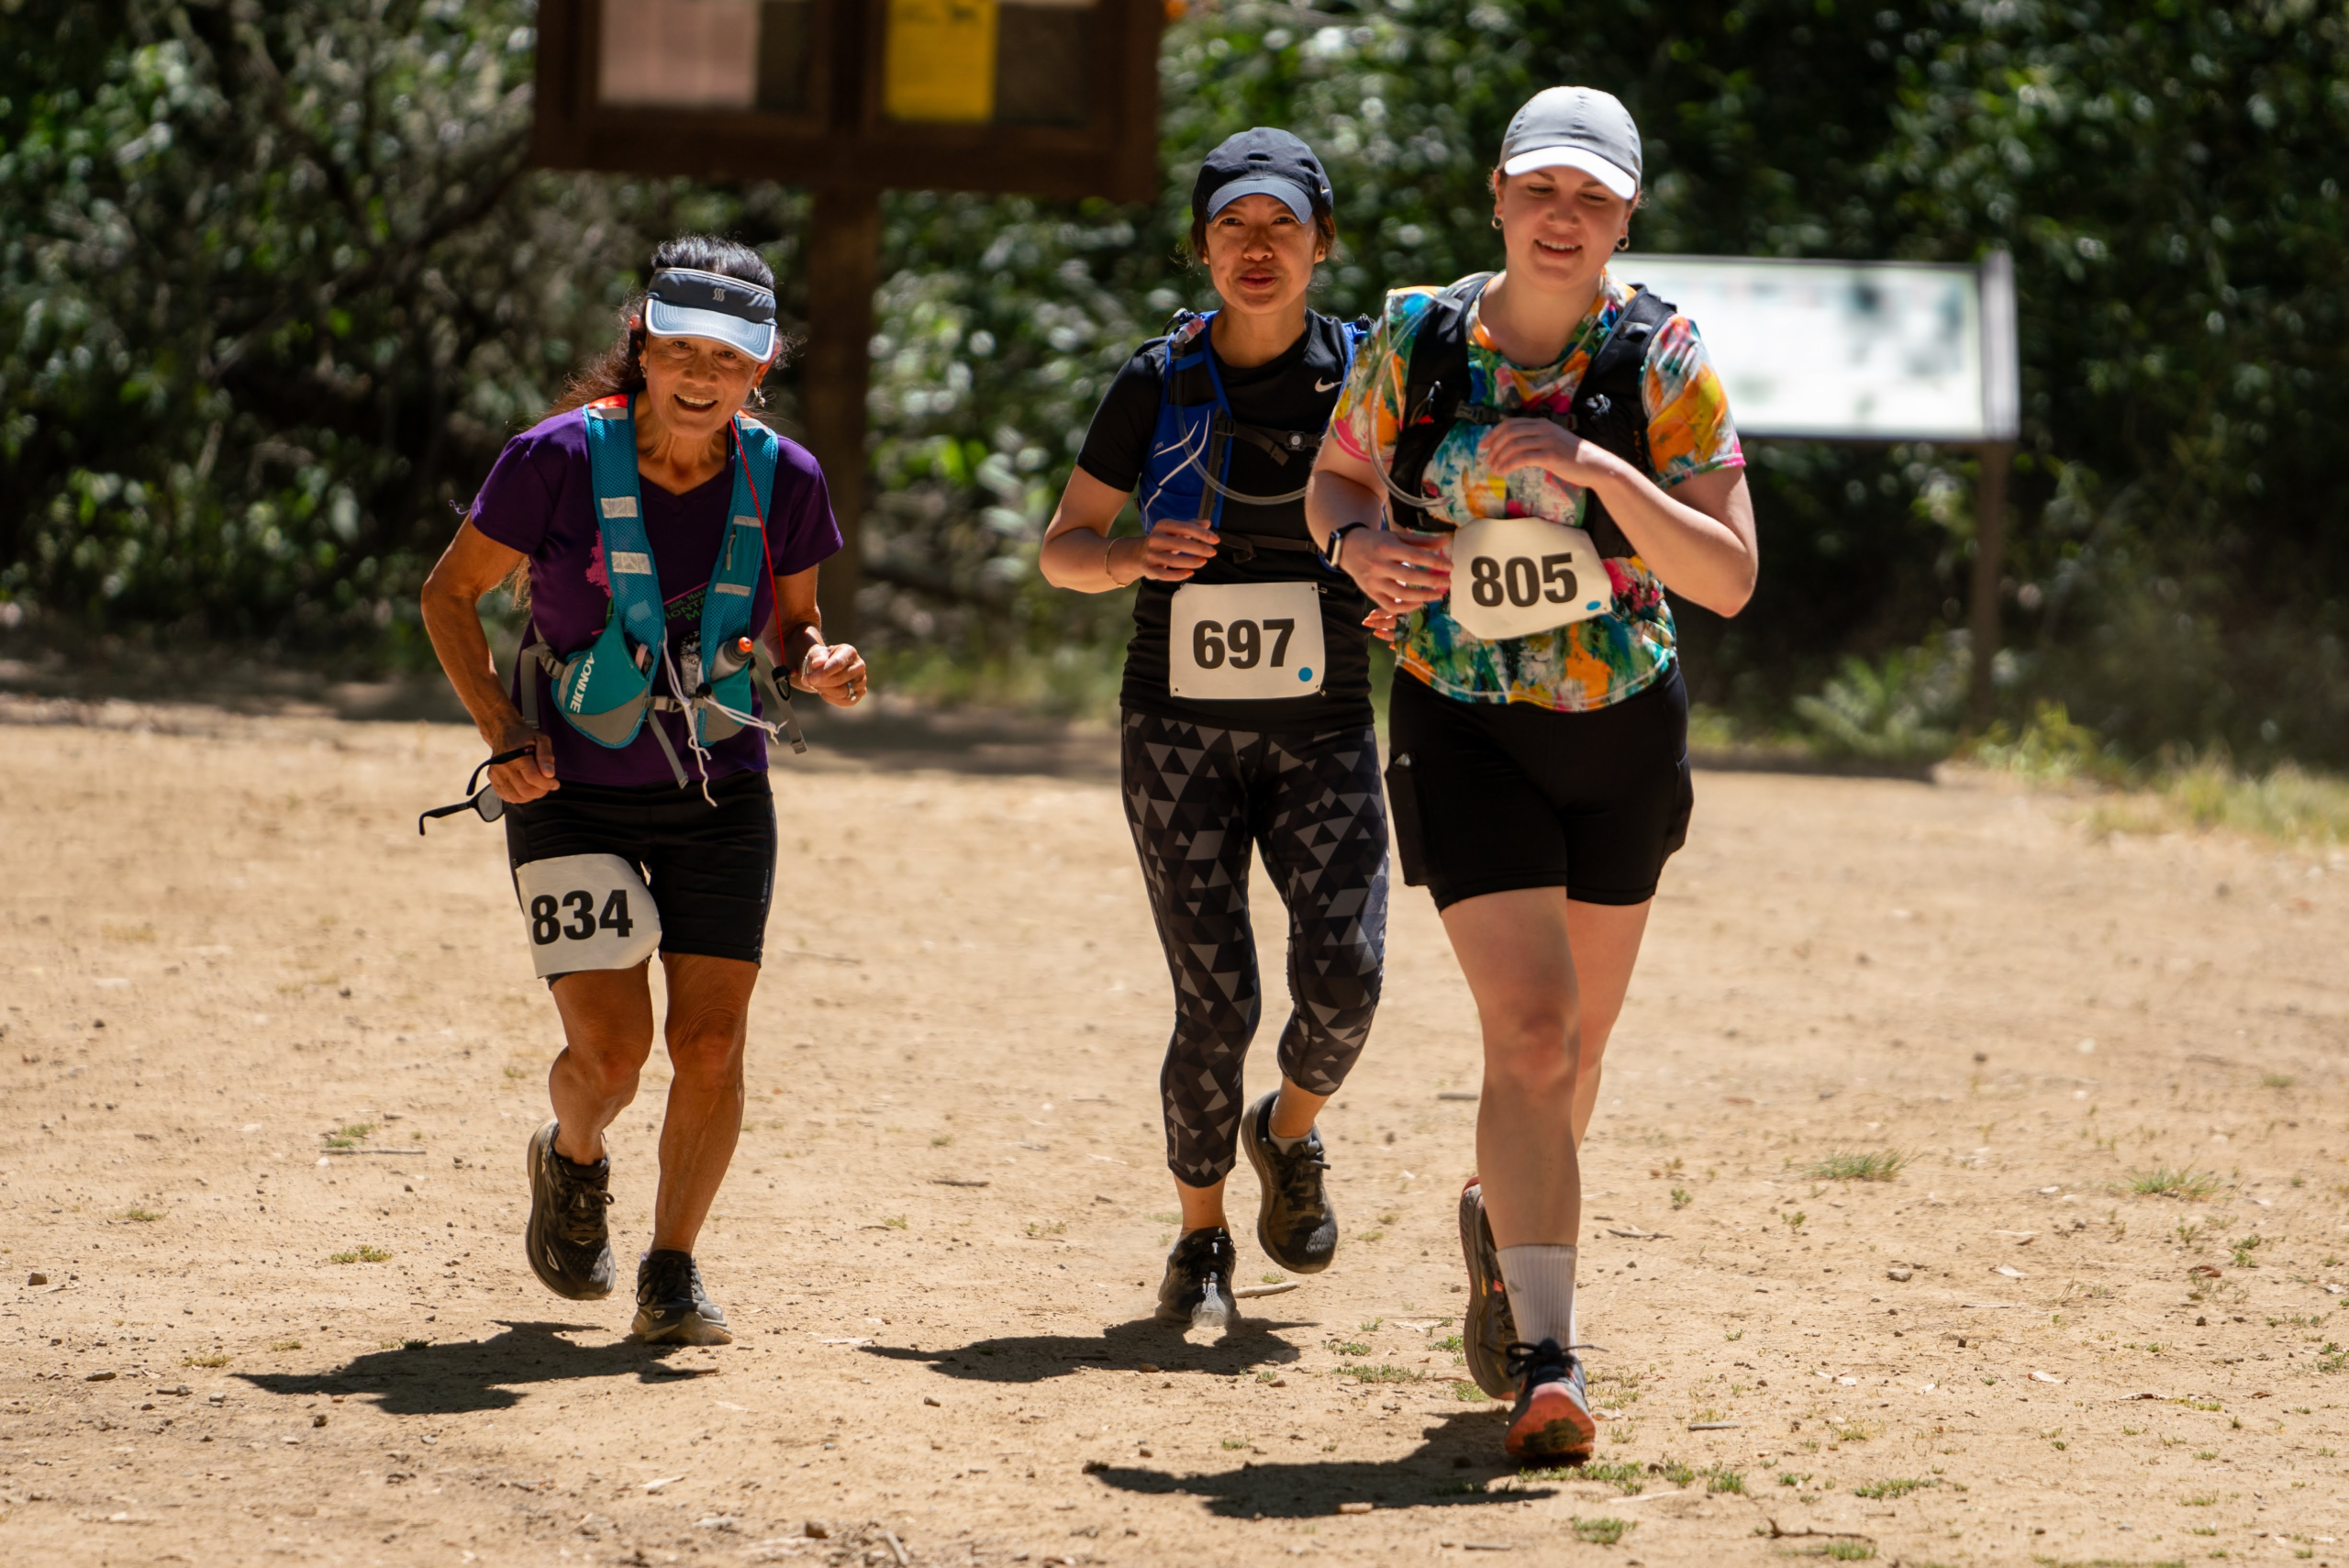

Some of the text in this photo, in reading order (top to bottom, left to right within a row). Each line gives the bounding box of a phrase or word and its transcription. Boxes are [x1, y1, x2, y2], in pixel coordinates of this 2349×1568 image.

[1471, 552, 1578, 607] 805
[1193, 618, 1295, 670] 697
[570, 651, 595, 714] AONIJIE
[530, 889, 633, 945] 834
